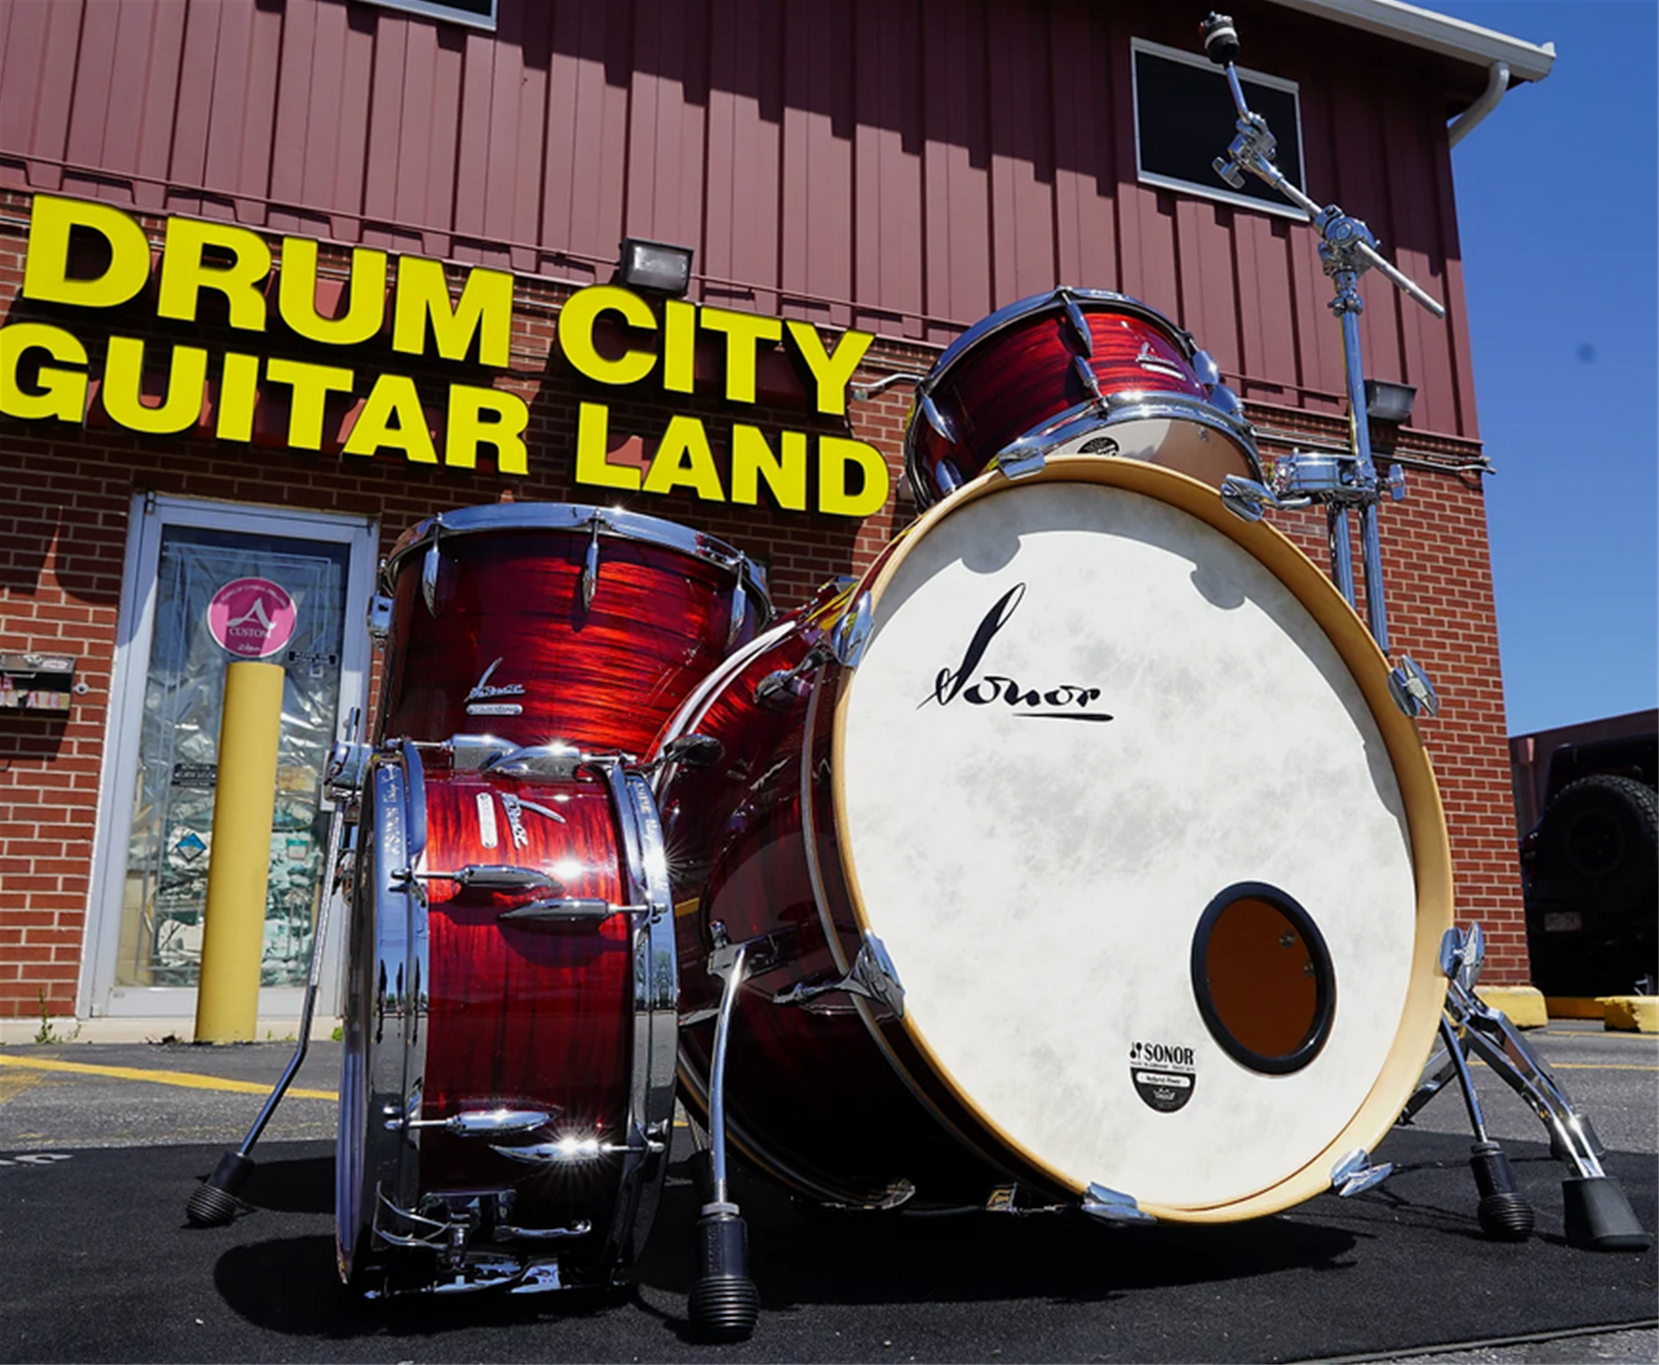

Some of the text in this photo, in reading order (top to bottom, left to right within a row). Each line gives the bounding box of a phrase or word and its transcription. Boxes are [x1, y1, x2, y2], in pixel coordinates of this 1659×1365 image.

[23, 195, 875, 416] DRUM CITY
[0, 322, 890, 517] GUITAR LAND
[229, 627, 272, 639] CUSTOM
[916, 582, 1102, 710] Sonor
[1144, 1043, 1194, 1065] SONOR
